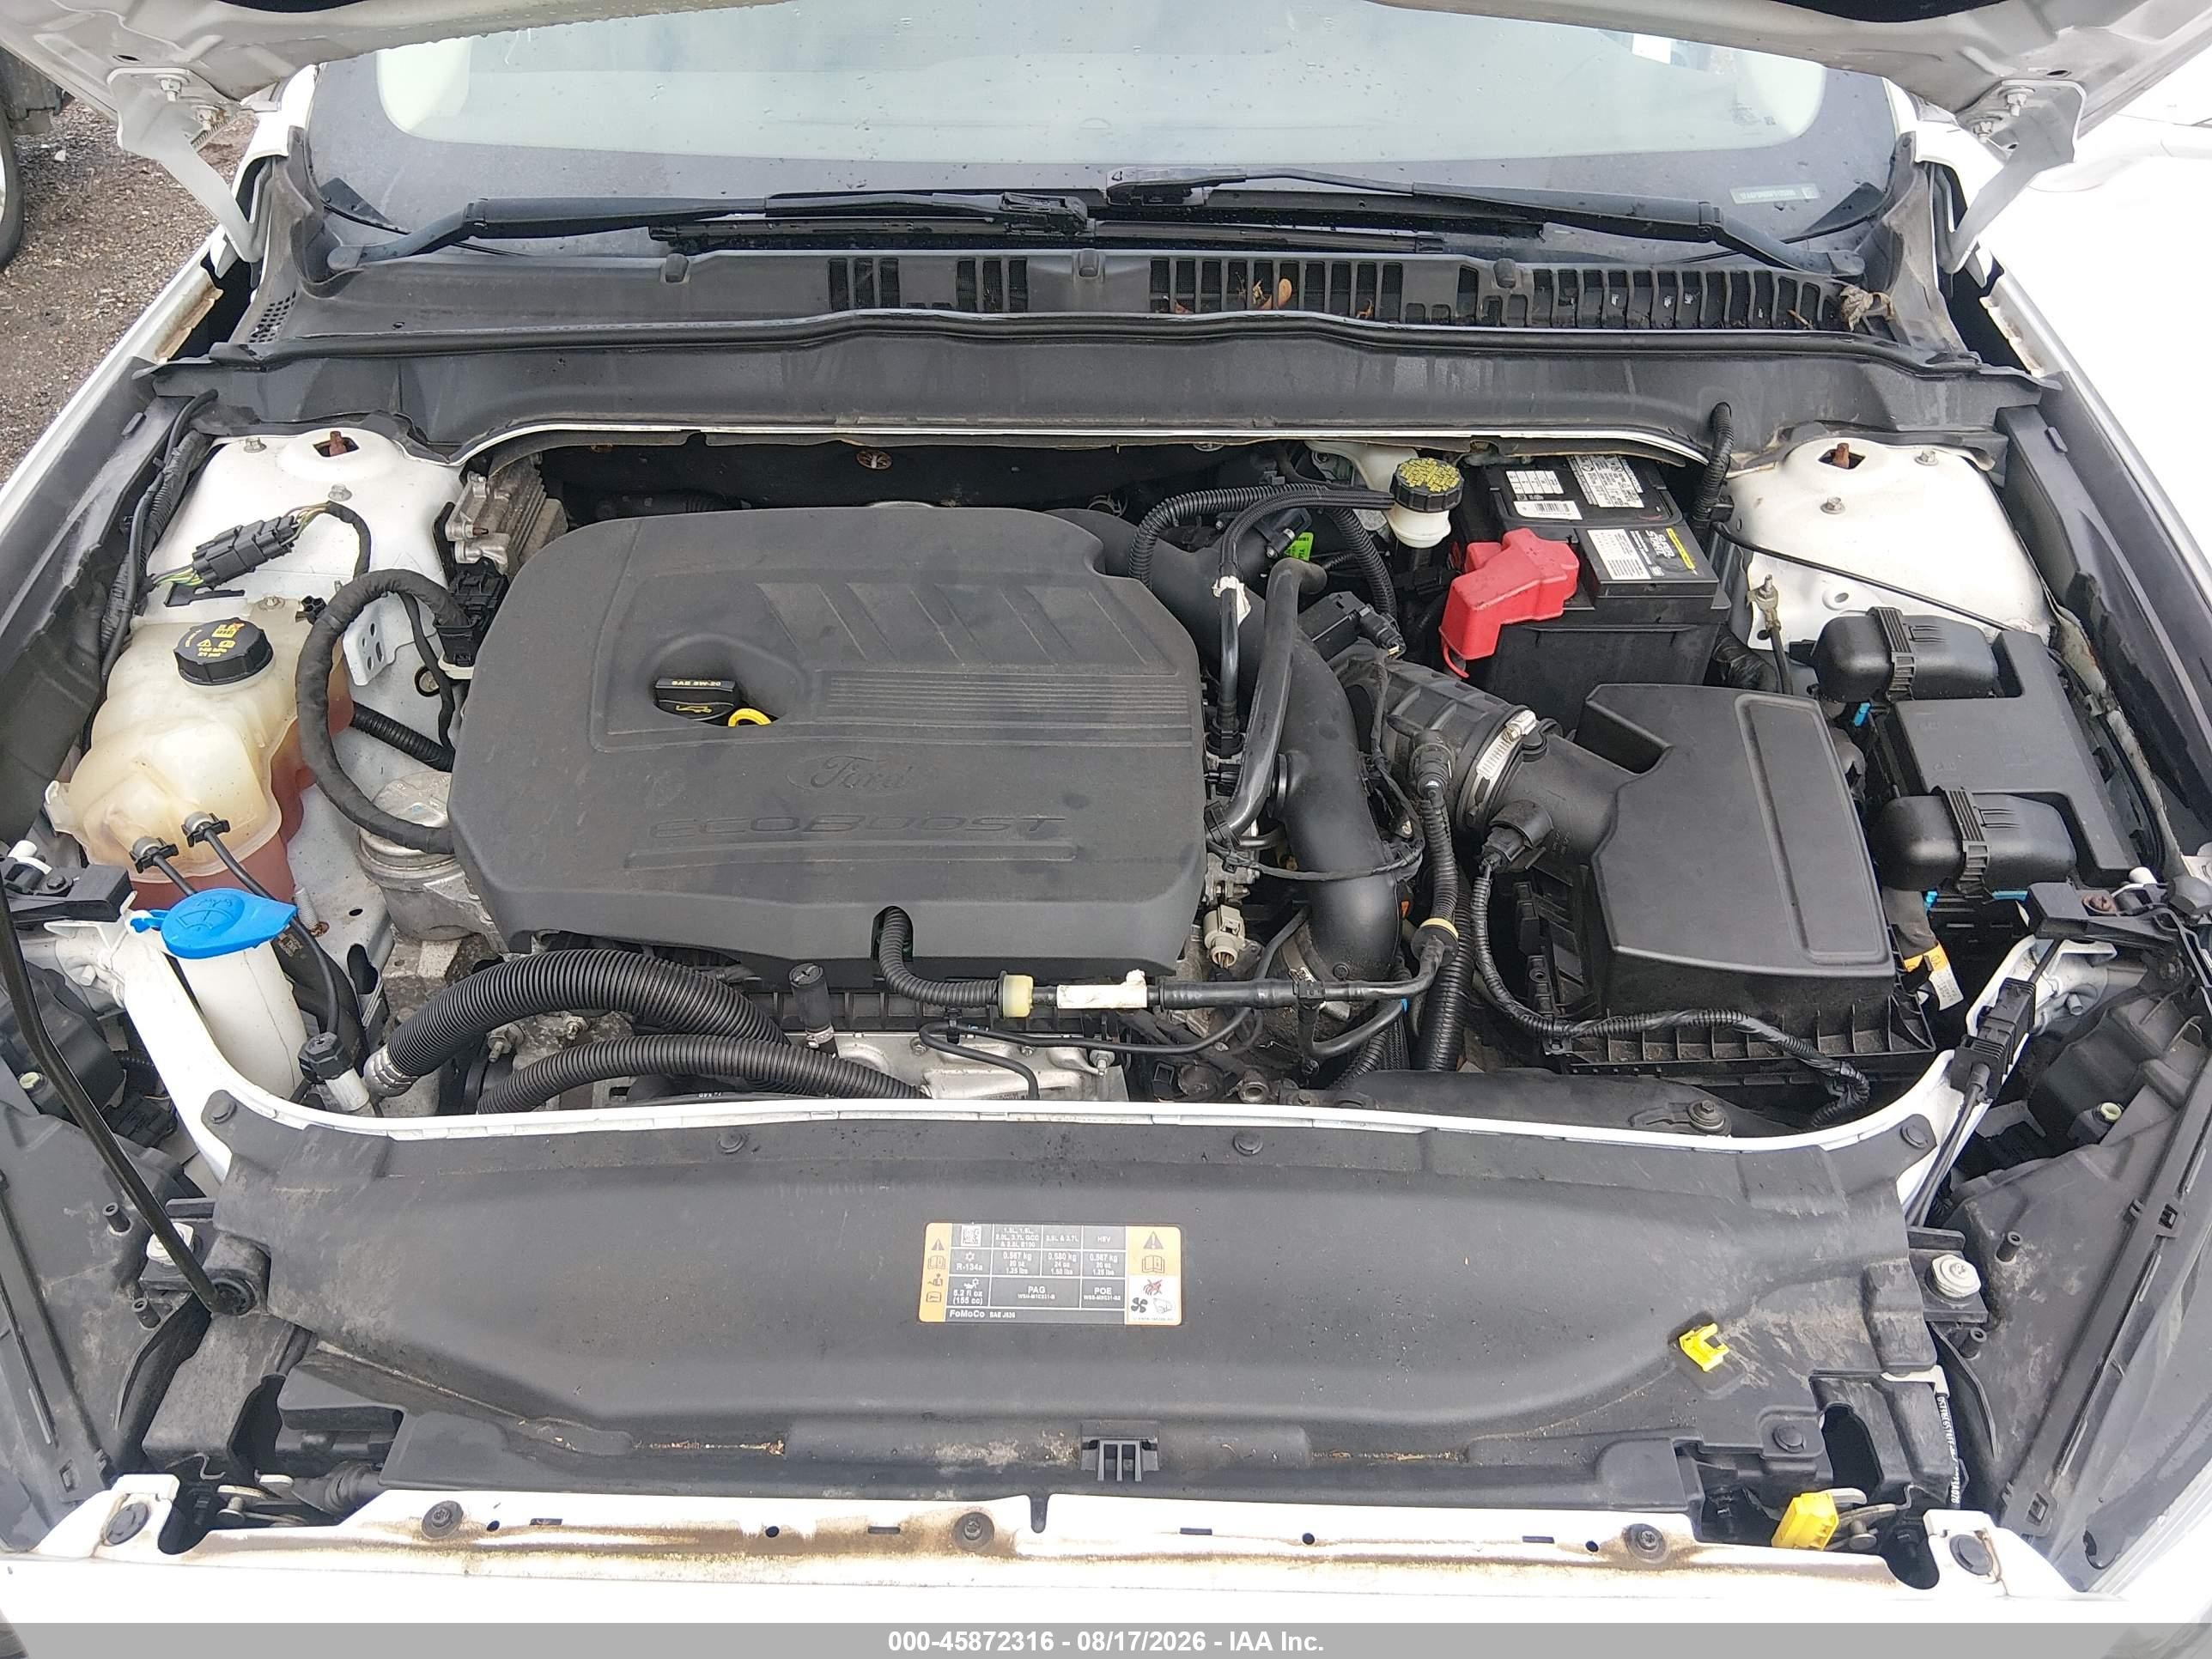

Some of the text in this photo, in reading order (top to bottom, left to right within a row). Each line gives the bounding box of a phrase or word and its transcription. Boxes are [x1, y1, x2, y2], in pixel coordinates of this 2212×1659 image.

[809, 754, 915, 790] Ford
[649, 813, 1066, 840] ECOBOOST
[956, 1262, 983, 1271] R-134a
[1027, 1285, 1046, 1294] PAG
[1093, 1286, 1112, 1295] POE
[949, 1309, 986, 1318] FoMoCo
